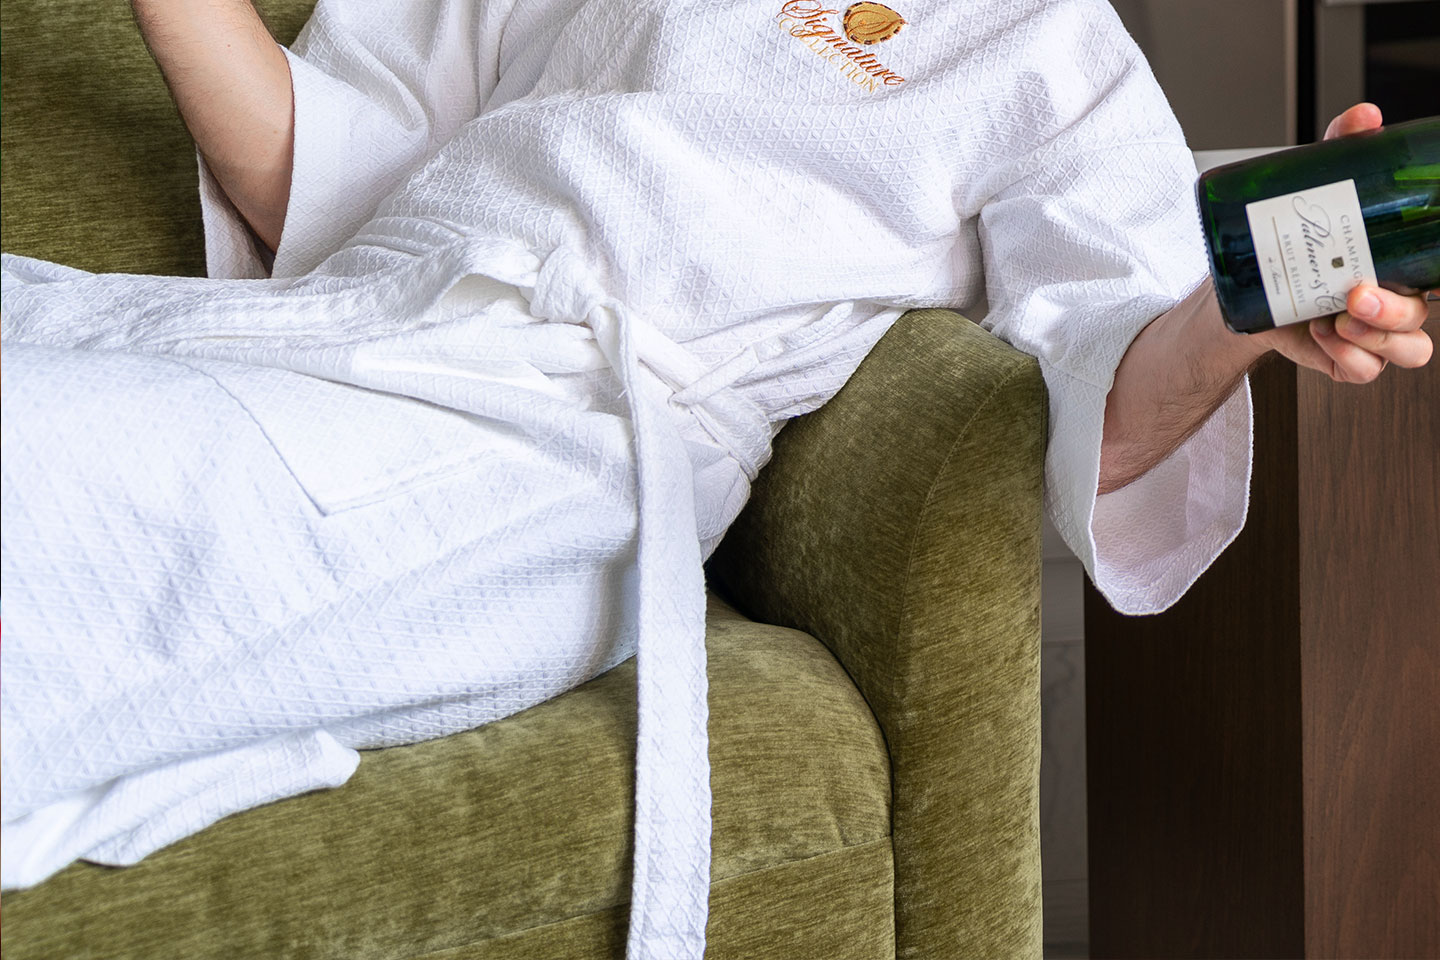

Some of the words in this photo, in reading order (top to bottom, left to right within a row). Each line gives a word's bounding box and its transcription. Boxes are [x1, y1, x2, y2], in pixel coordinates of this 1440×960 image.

[1282, 234, 1297, 266] BRUT
[1292, 195, 1336, 277] Palmer
[1340, 214, 1364, 287] CHAMPAGN
